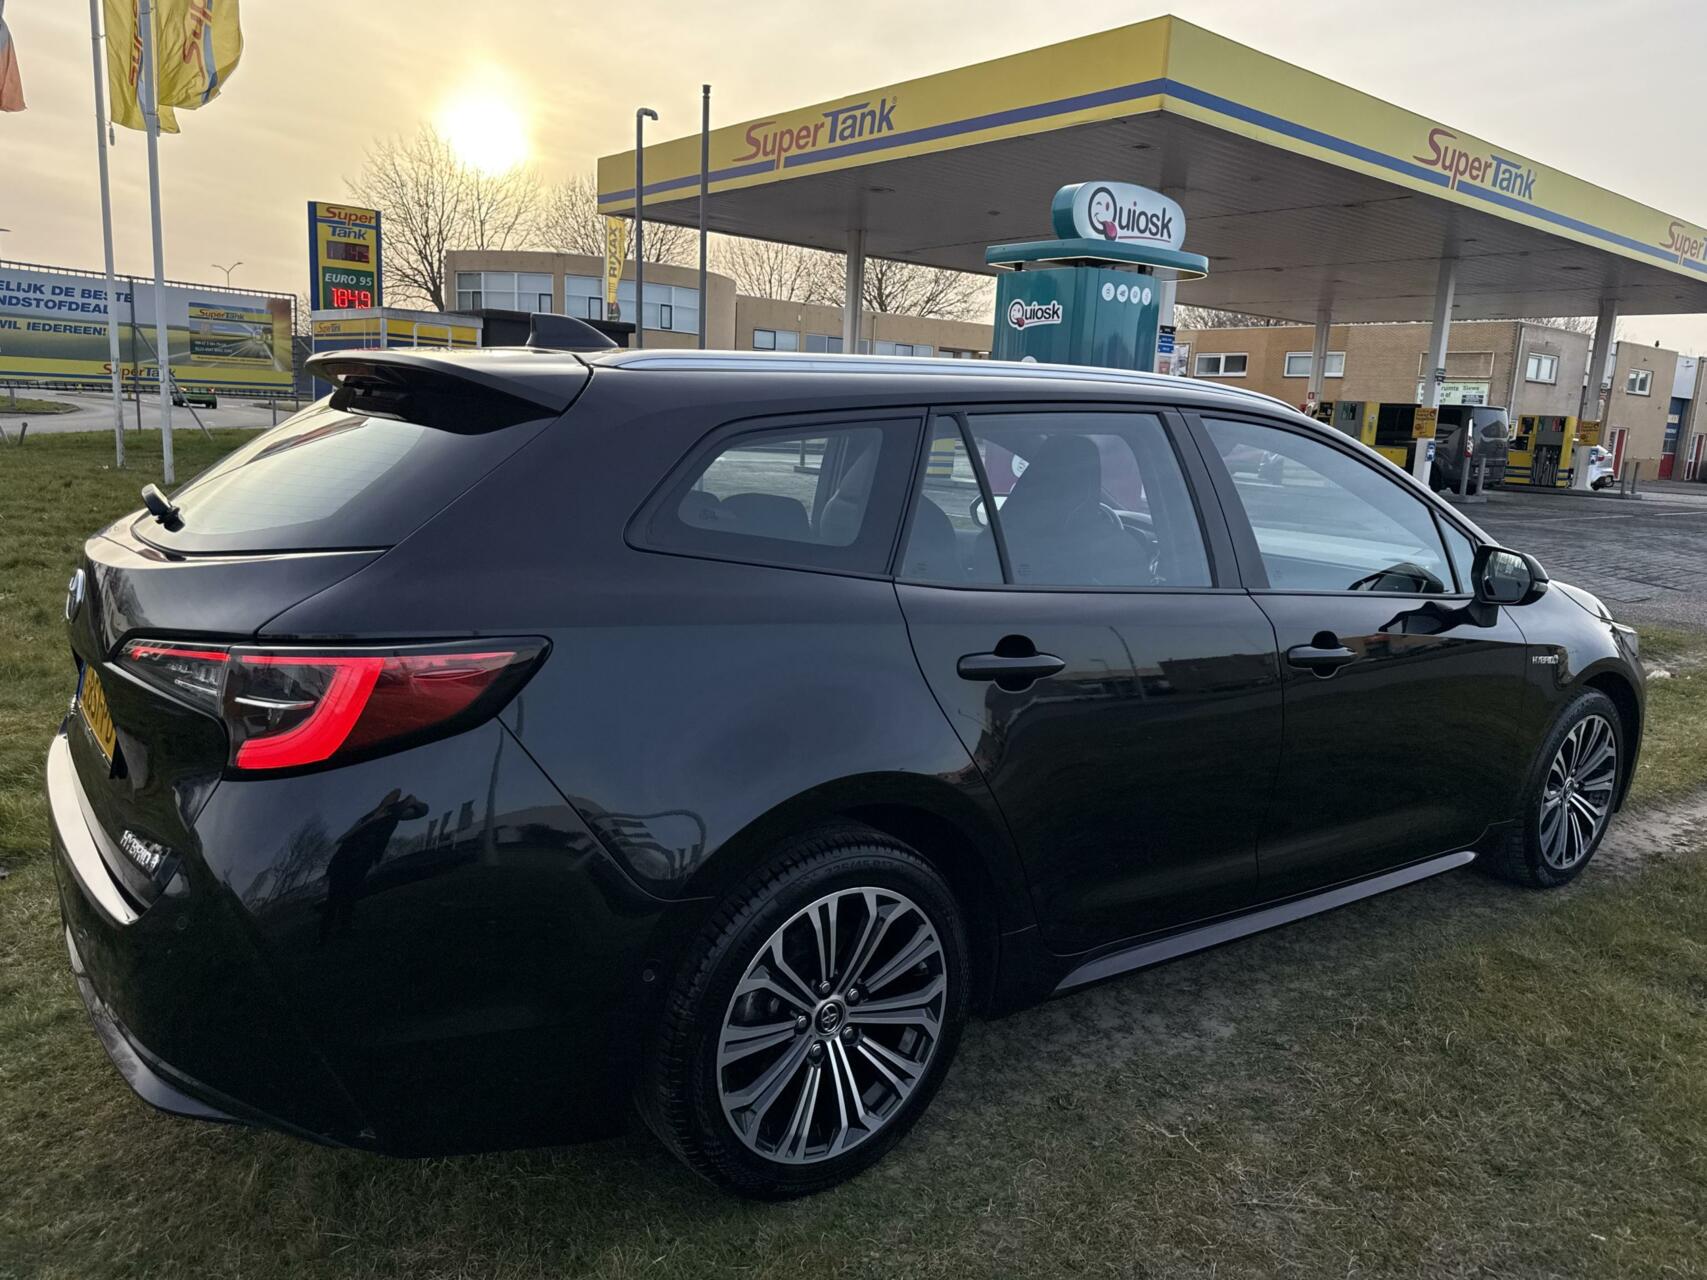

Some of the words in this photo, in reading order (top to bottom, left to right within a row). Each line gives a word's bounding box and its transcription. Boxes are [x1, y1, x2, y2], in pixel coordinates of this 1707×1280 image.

[731, 97, 898, 170] SuperTank
[1412, 127, 1536, 201] SuperTank
[325, 206, 375, 227] Super
[1087, 186, 1173, 241] Quiosk
[327, 224, 368, 241] Tank
[51, 285, 75, 298] DE
[325, 273, 357, 285] EURO
[359, 276, 373, 287] 95
[1008, 300, 1061, 328] Quiosk
[26, 322, 107, 336] IEDEREEN!
[120, 830, 152, 866] HYBRID
